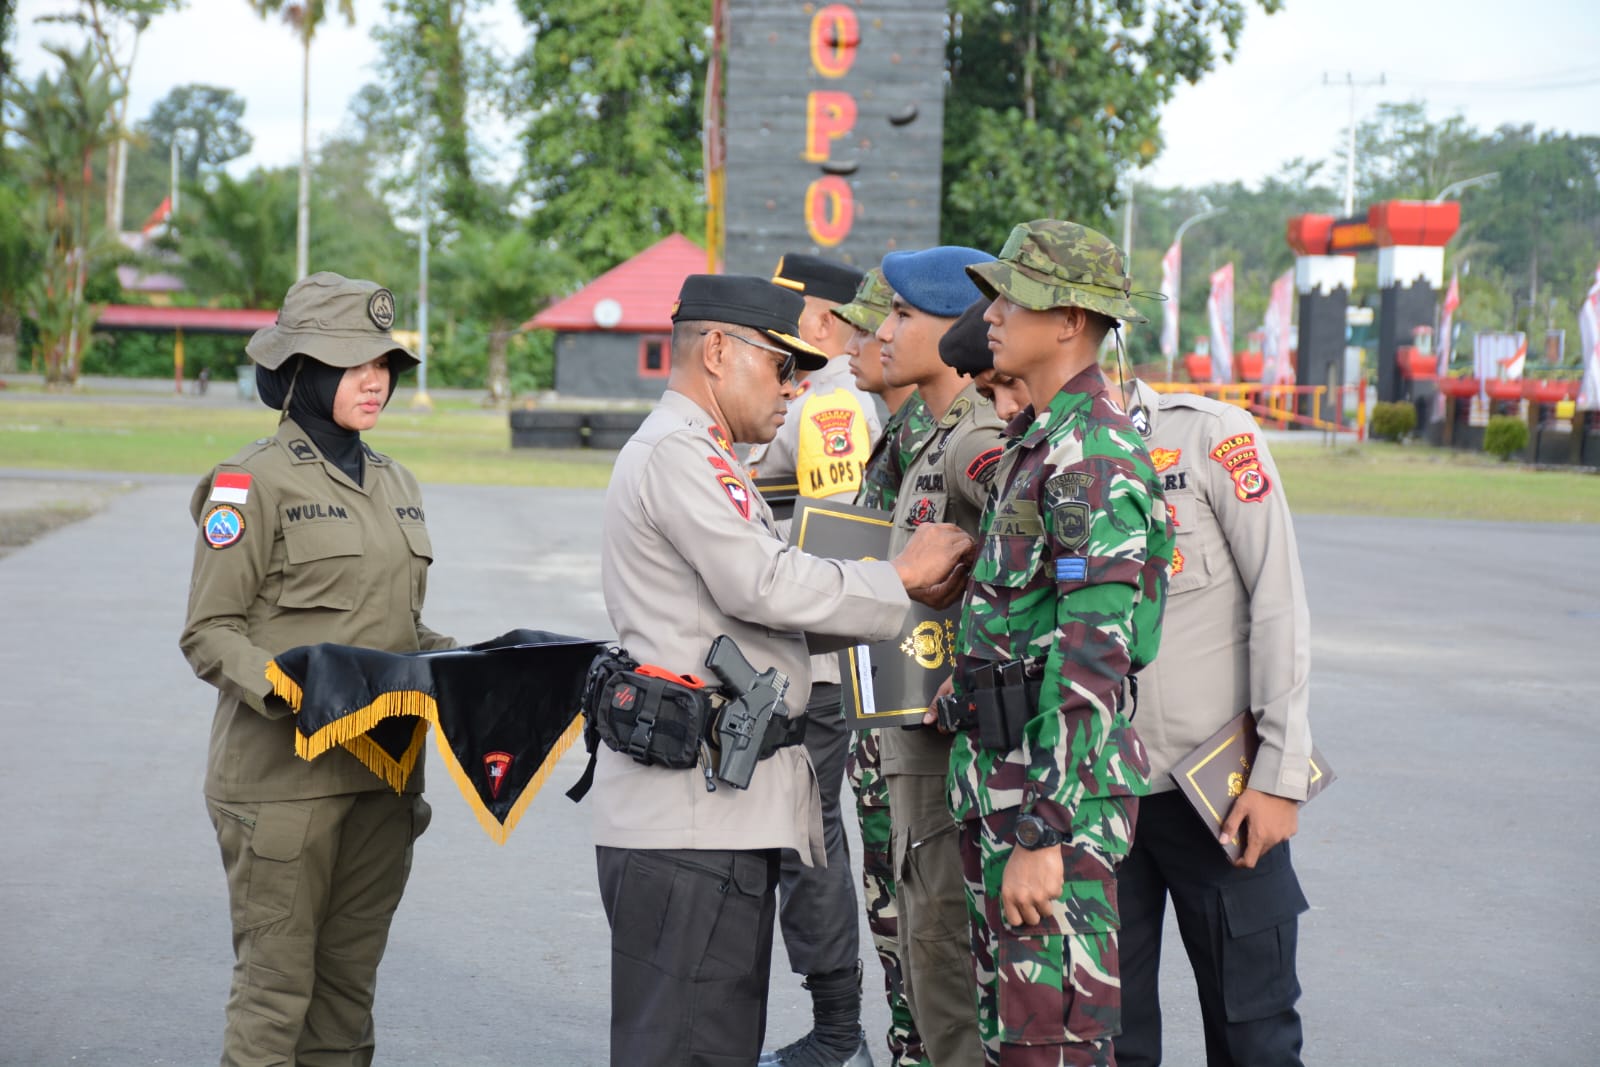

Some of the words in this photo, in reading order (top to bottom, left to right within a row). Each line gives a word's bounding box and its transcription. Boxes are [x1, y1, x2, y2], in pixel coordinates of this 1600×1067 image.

[1215, 434, 1251, 459] POLDA
[1227, 451, 1255, 467] PAPUA
[810, 467, 824, 492] KA
[829, 460, 854, 484] OPS
[286, 503, 349, 522] WULAN
[395, 506, 425, 522] POL
